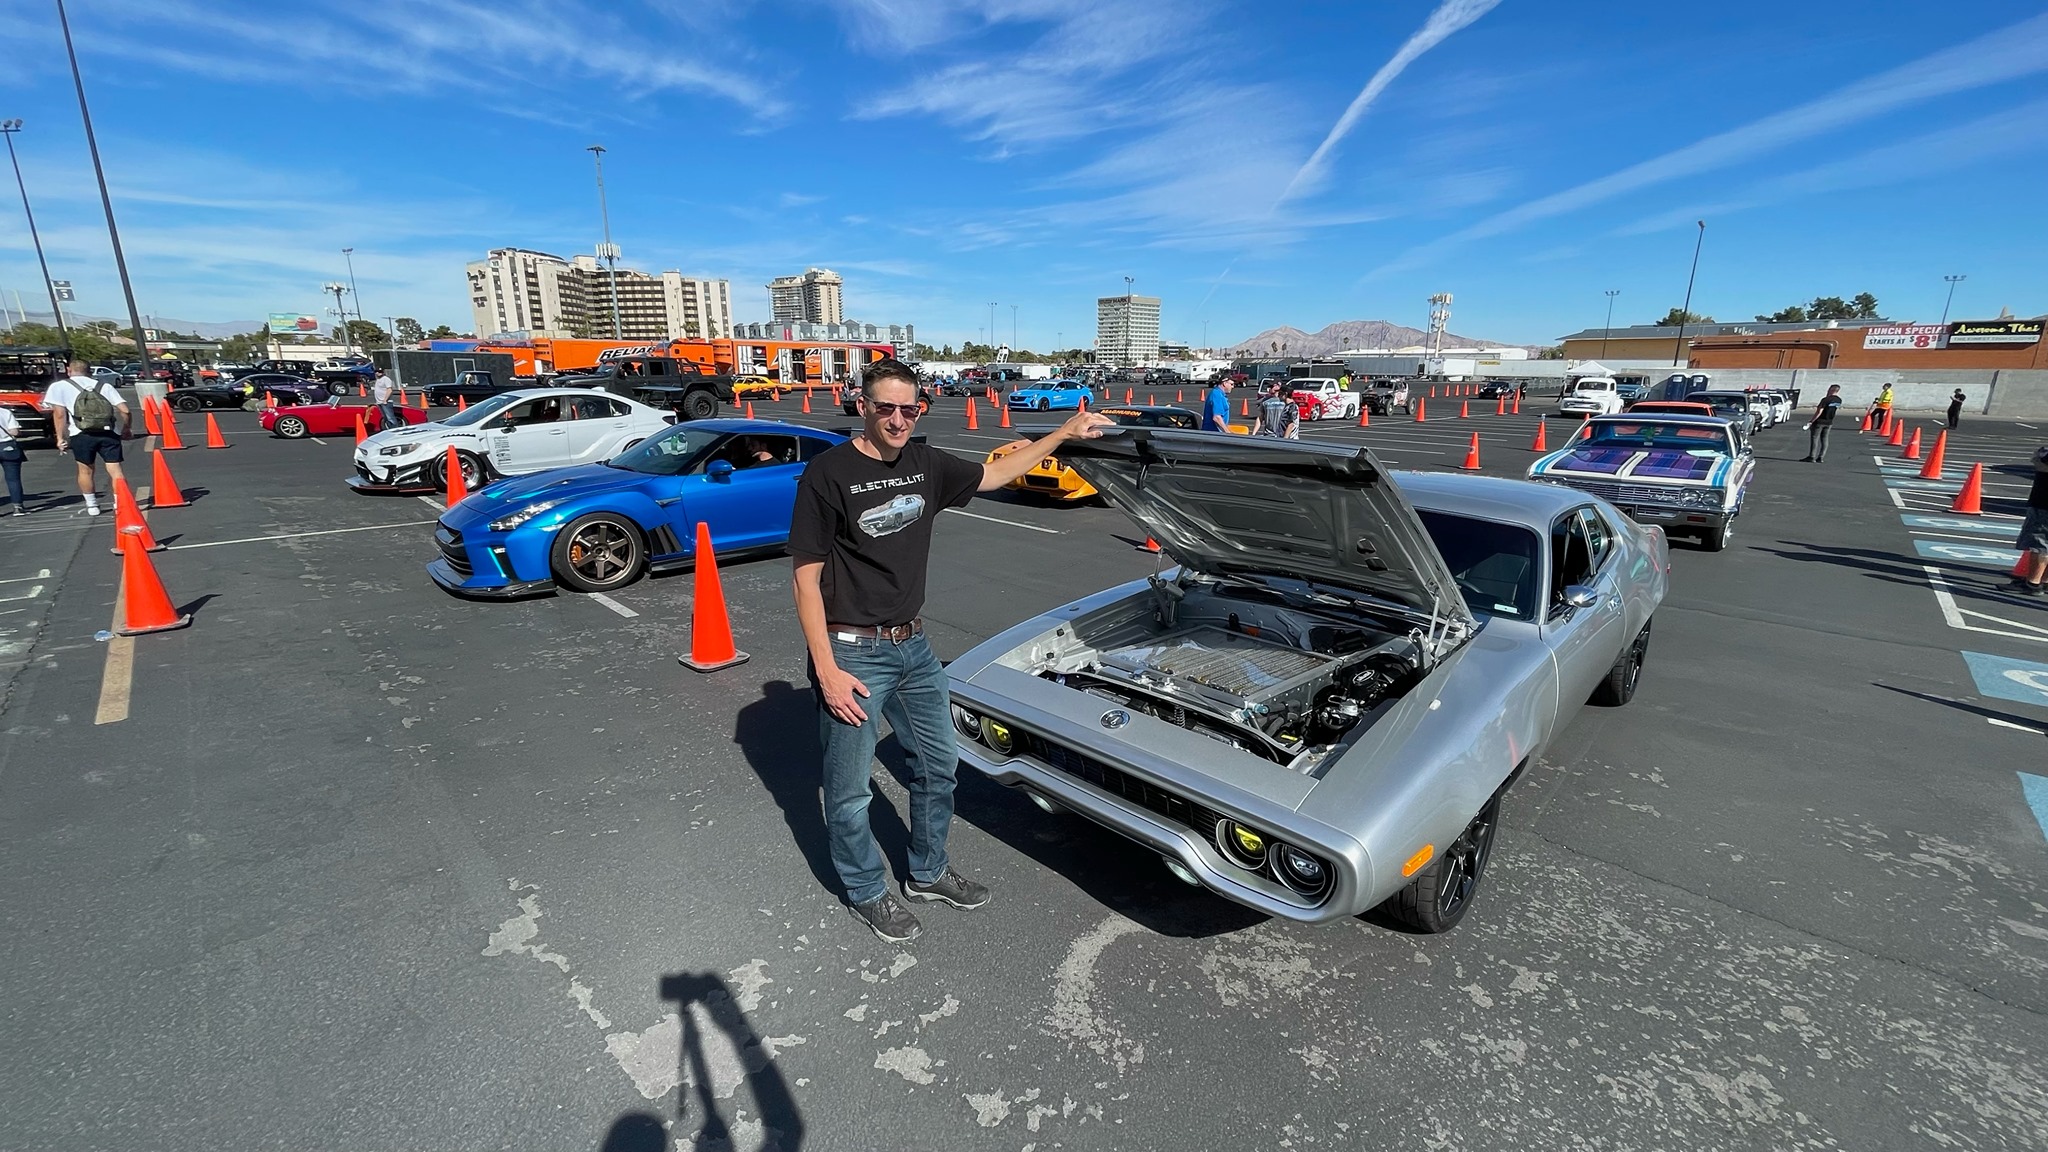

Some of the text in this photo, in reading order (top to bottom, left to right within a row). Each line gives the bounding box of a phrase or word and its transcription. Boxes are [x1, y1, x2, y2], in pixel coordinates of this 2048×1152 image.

[1867, 327, 1902, 335] LUNCH
[1954, 323, 2040, 335] Awesome Thai
